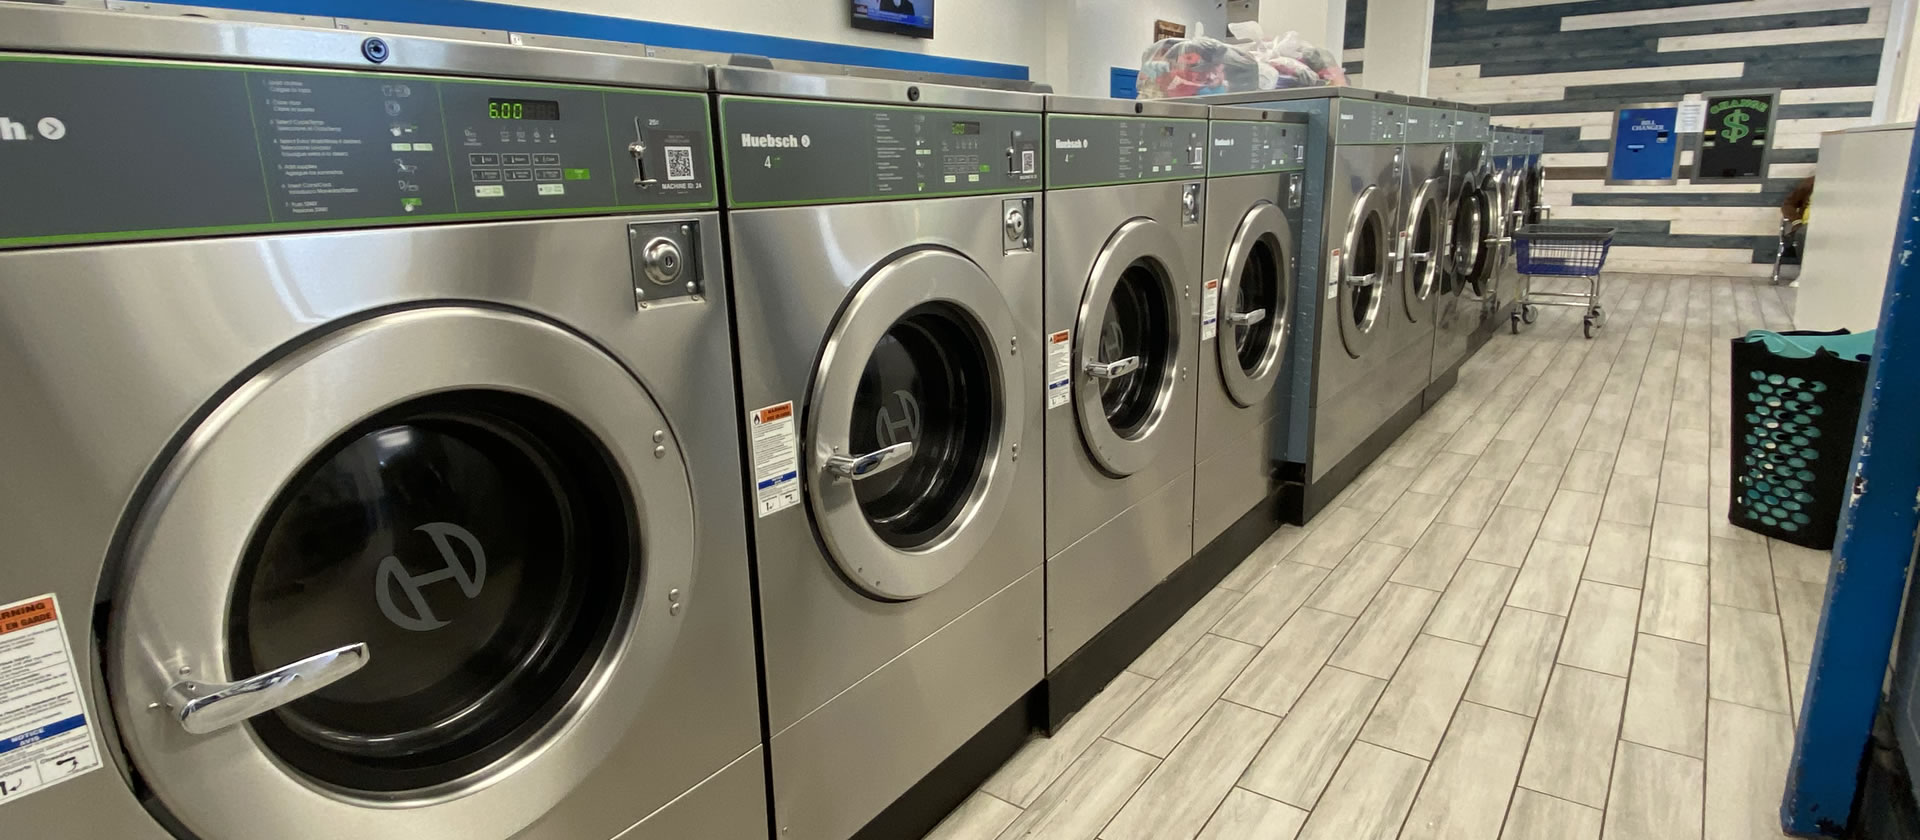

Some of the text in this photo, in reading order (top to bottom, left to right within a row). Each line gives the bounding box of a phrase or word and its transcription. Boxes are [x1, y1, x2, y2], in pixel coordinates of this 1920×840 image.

[489, 102, 522, 119] 6.00
[741, 133, 798, 147] Huebsch
[764, 155, 771, 168] 4
[0, 602, 45, 620] RNING
[21, 612, 52, 626] GARDE
[11, 727, 45, 742] NOTICE
[20, 736, 40, 746] AVIS
